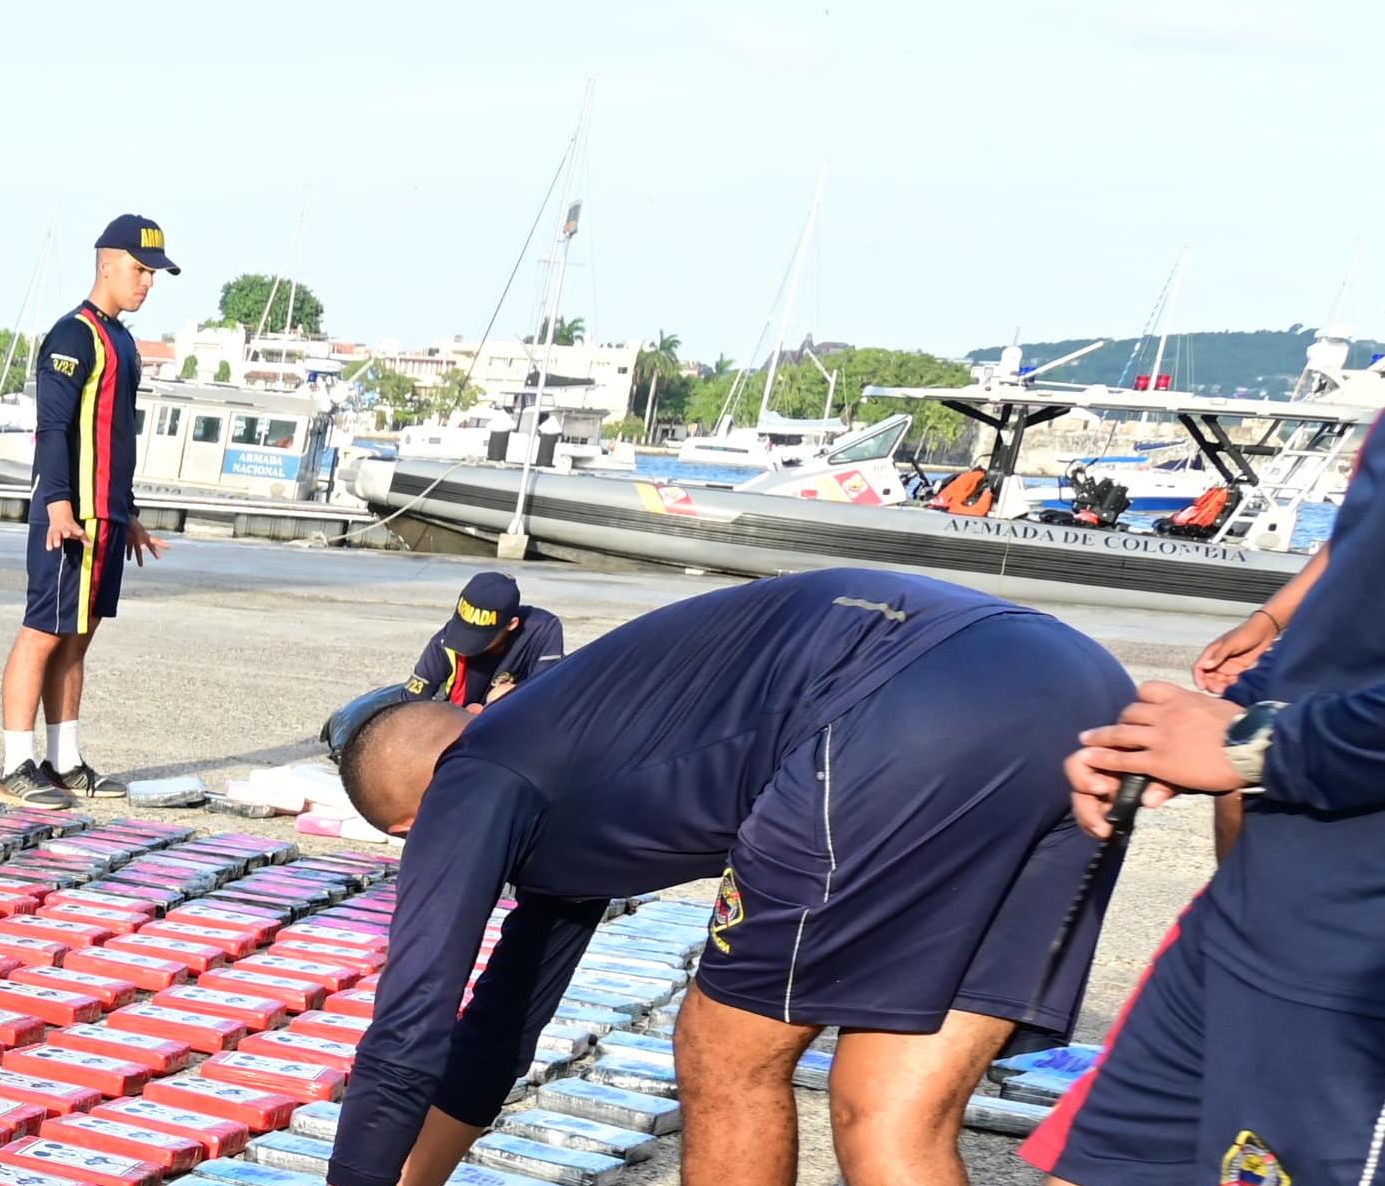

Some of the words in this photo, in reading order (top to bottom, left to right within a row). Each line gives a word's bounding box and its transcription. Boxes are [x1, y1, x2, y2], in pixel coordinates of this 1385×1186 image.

[238, 451, 283, 466] ARMADA
[232, 463, 286, 477] NACIONAL
[944, 518, 1055, 543] ARMADA
[1064, 530, 1095, 546] DE
[1104, 536, 1247, 563] COLOMBIA
[457, 597, 497, 626] ARMADA
